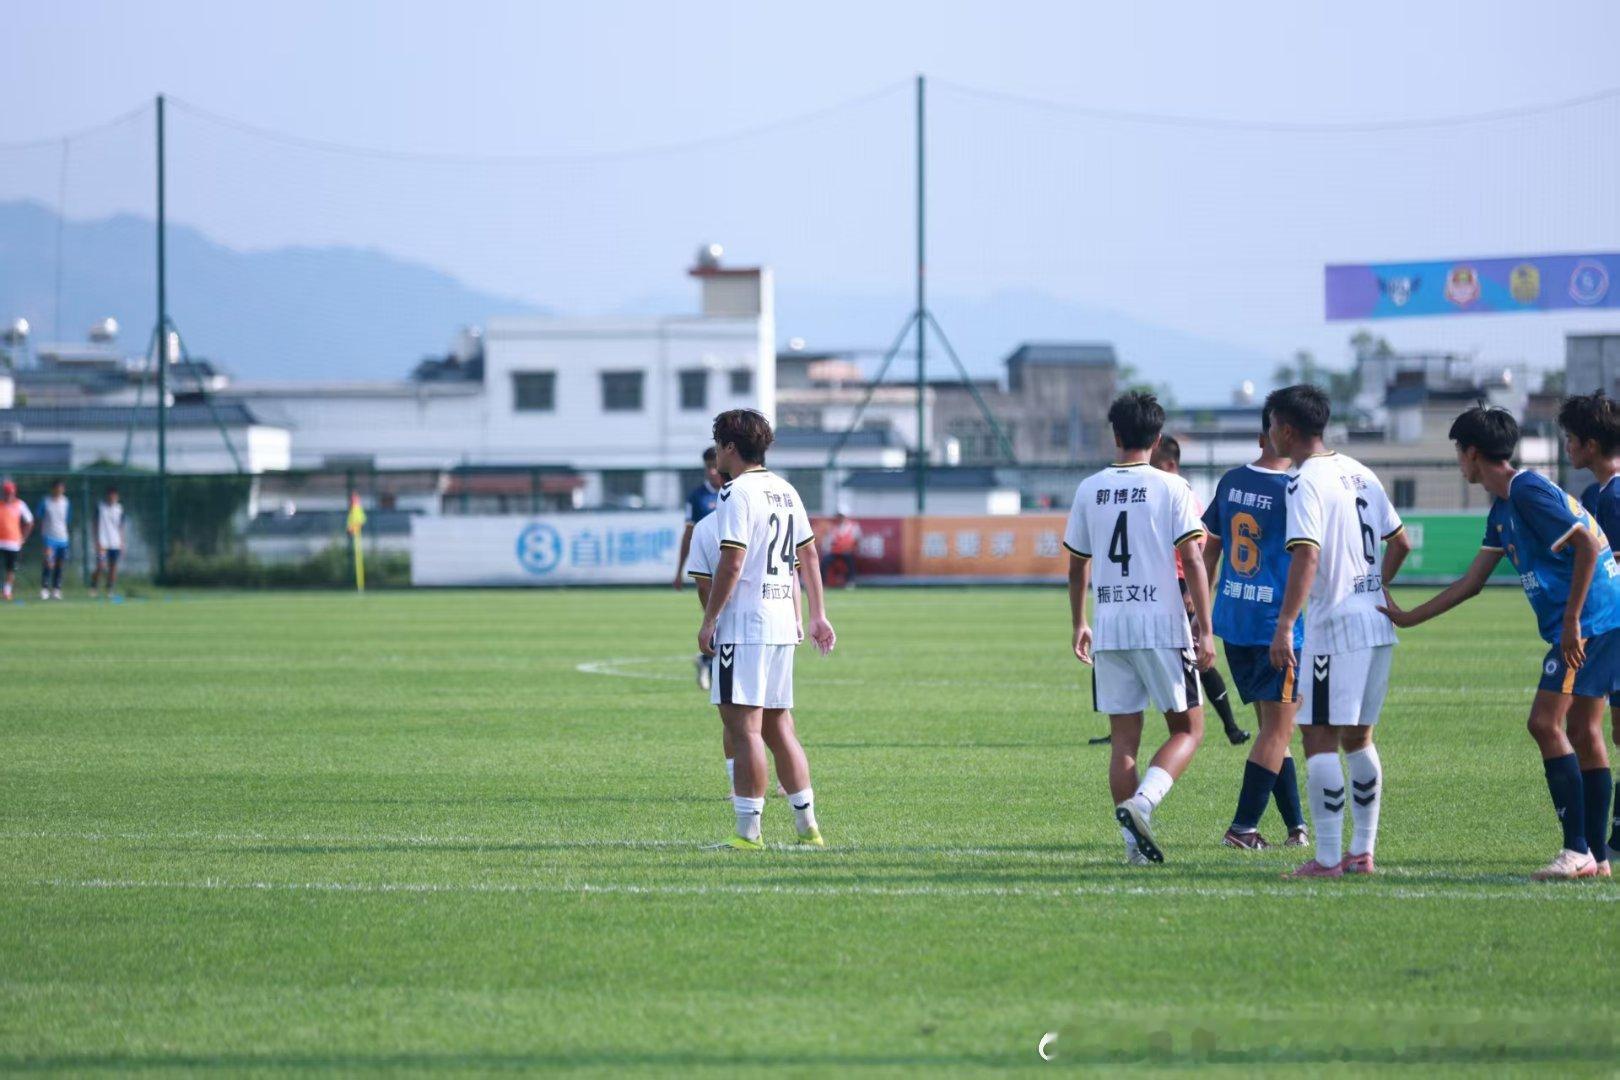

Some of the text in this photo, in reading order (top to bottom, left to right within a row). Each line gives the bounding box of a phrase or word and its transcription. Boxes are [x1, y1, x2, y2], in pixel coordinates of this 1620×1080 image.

[1096, 487, 1147, 505] 郭博然
[766, 512, 795, 576] 24
[1108, 510, 1132, 577] 4
[1230, 512, 1261, 578] 6
[1355, 496, 1376, 566] 6
[1097, 584, 1157, 604] 振远文化
